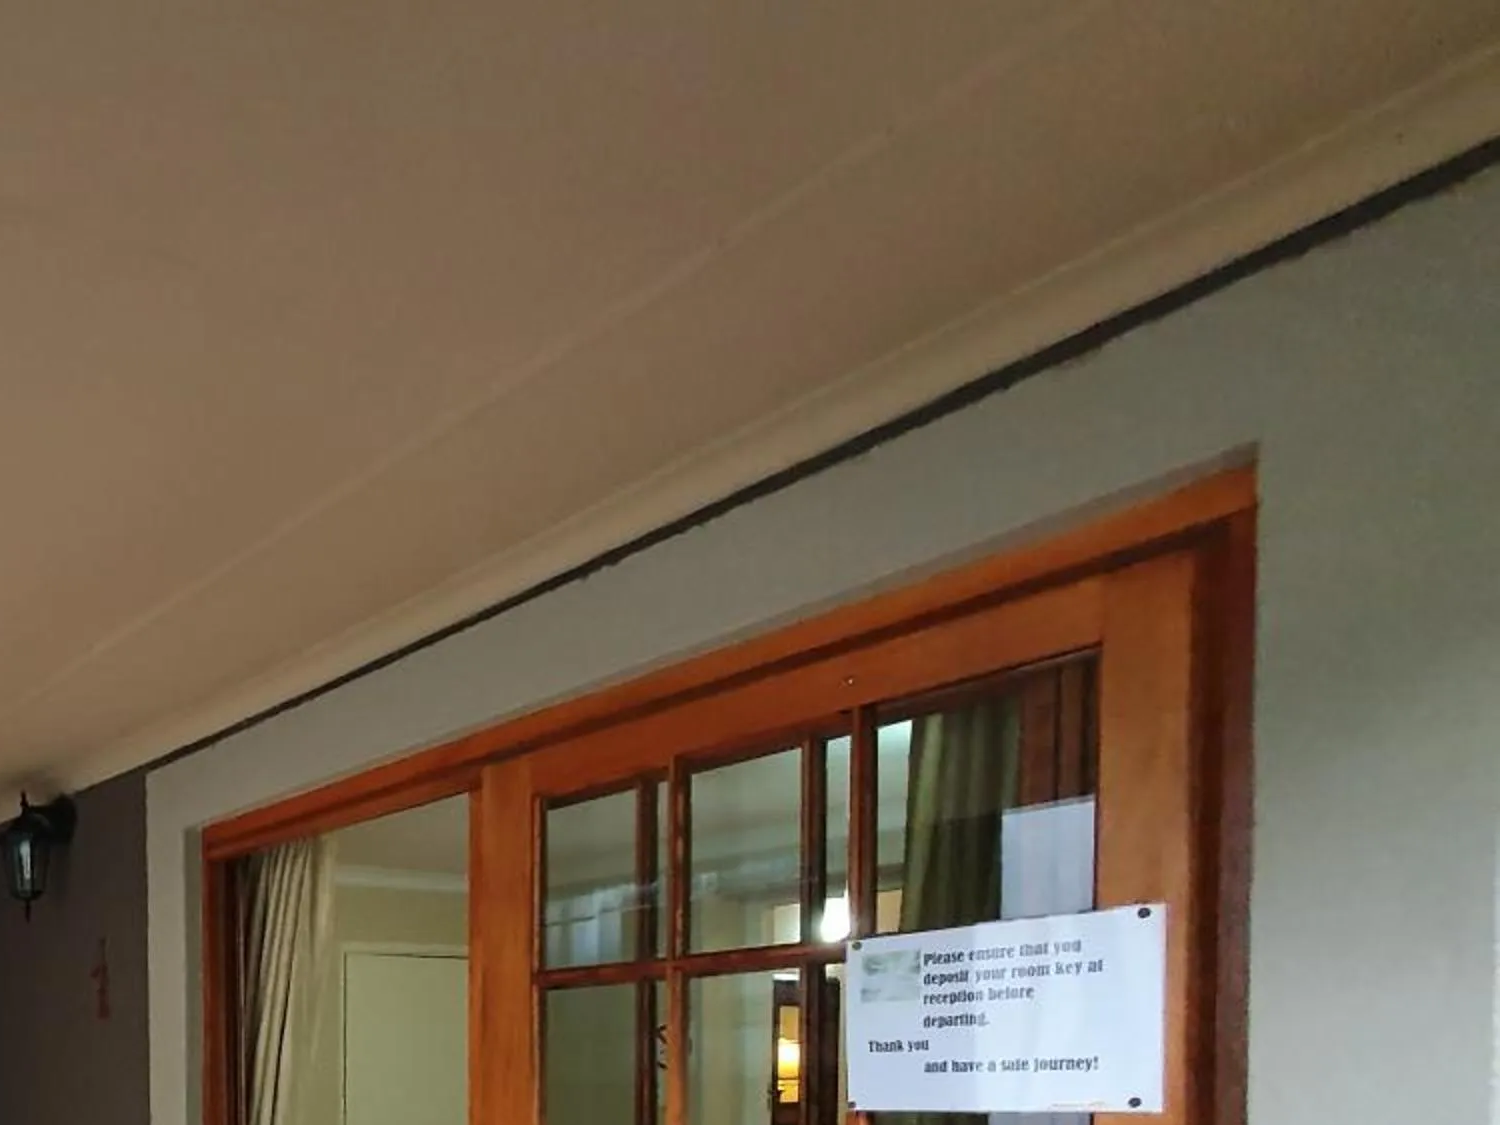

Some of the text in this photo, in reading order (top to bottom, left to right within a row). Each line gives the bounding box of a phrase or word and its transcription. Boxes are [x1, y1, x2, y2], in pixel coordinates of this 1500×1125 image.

[923, 940, 1082, 966] Please ensure that you
[923, 959, 1103, 986] deposit your room key at
[88, 960, 111, 1019] 1
[923, 986, 1034, 1005] reception before
[868, 1039, 929, 1052] Thank you
[924, 1056, 1099, 1073] and have a safe journey!
